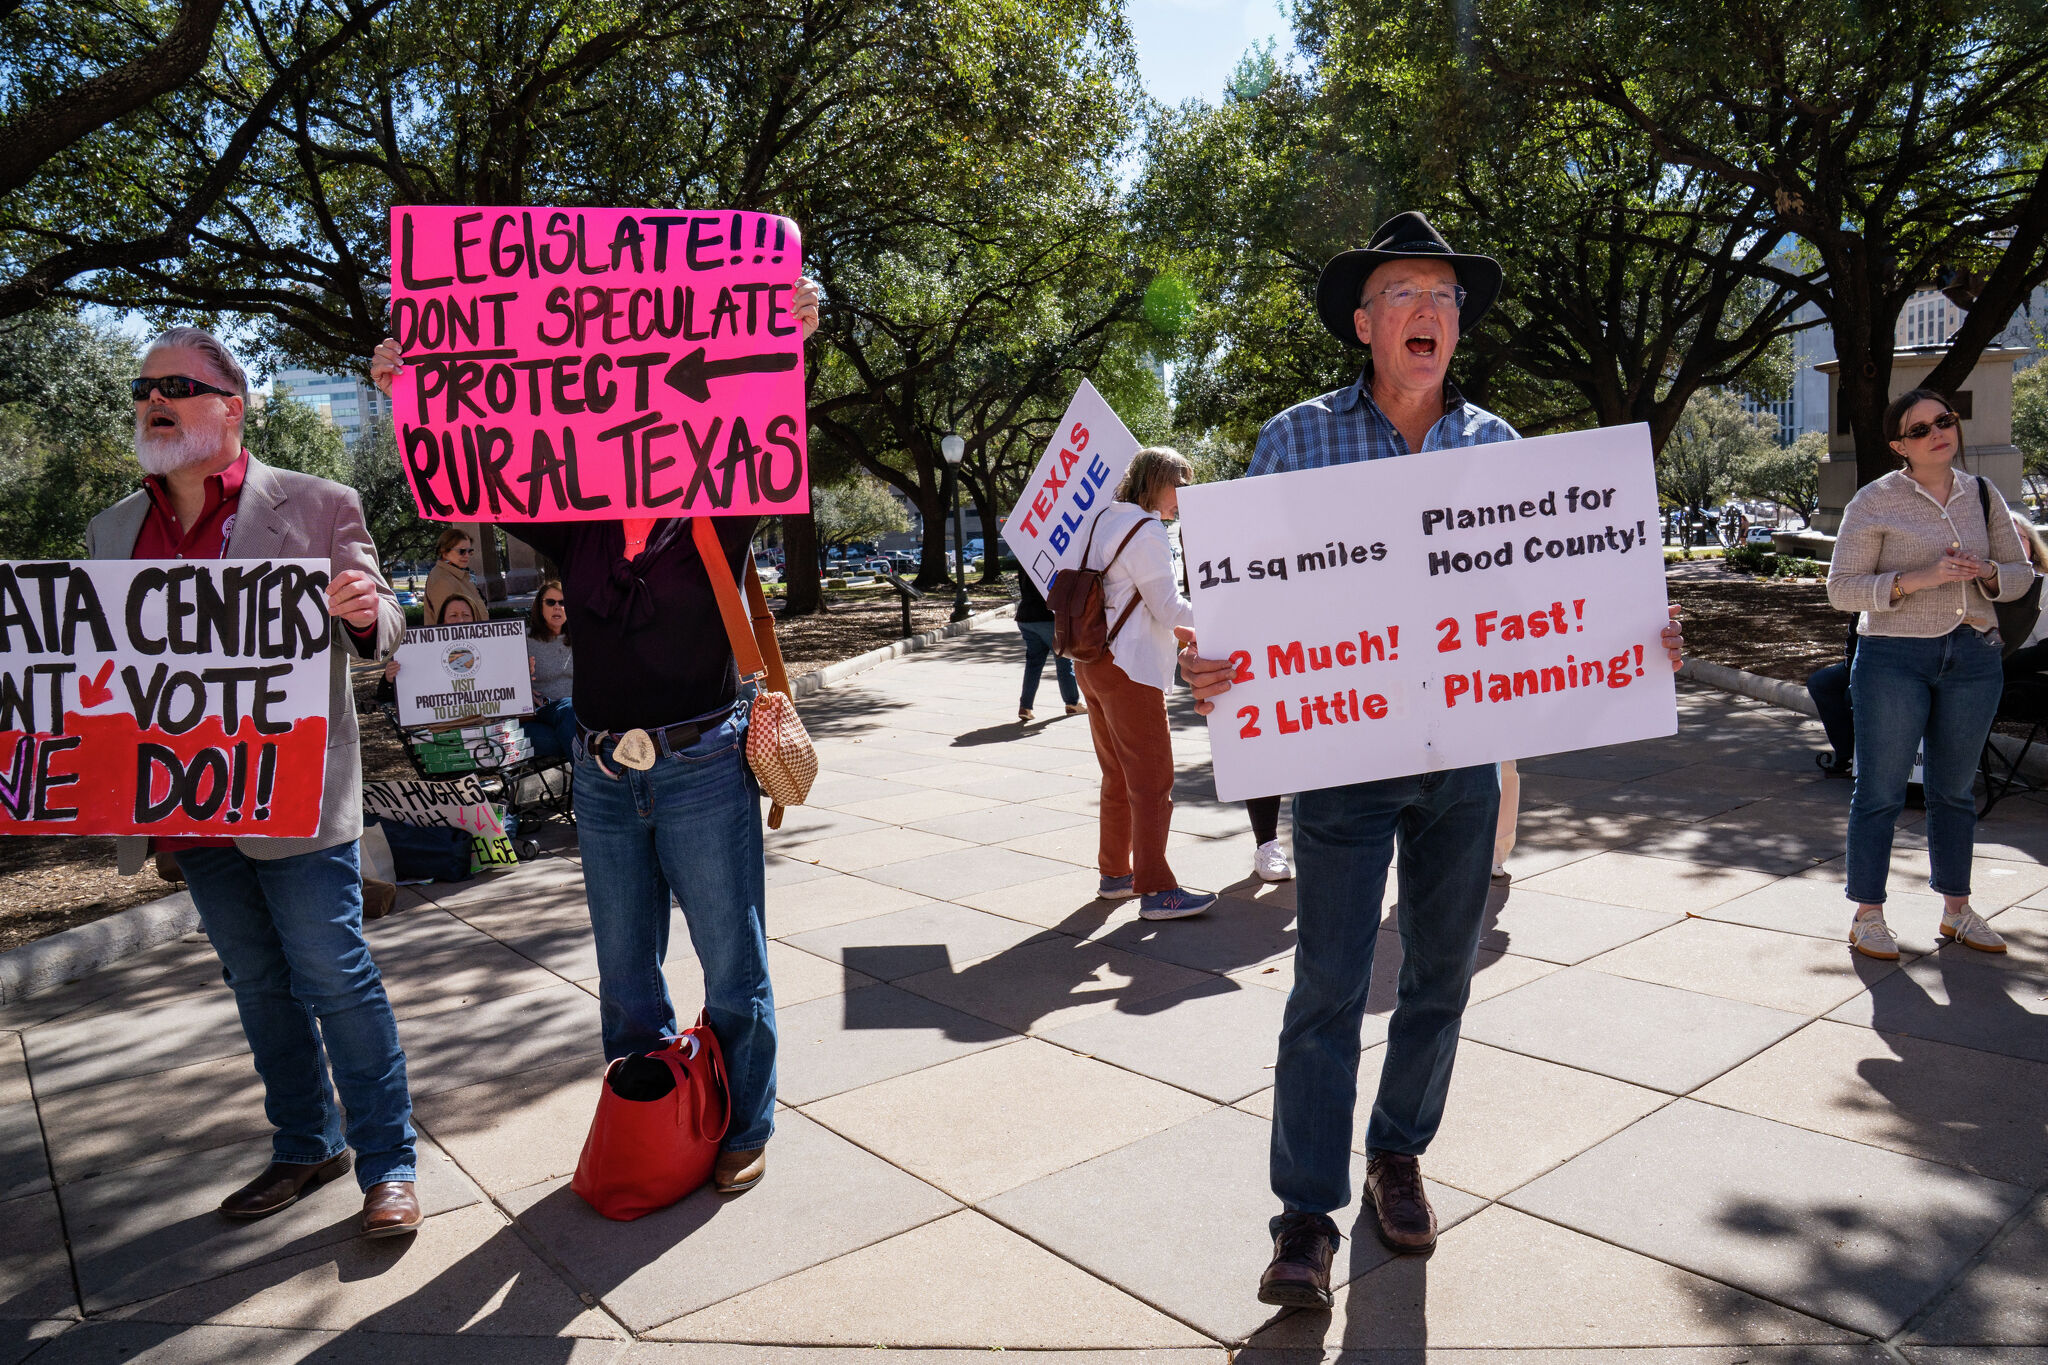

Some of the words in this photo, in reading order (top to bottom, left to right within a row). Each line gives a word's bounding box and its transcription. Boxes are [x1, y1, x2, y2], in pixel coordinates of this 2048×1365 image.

[400, 211, 787, 290] LEGISLATE!!!
[391, 291, 519, 352] DONT
[537, 283, 797, 348] SPECULATE
[415, 352, 671, 425] PROTECT
[403, 423, 611, 518] RURAL
[597, 411, 803, 510] TEXAS
[1019, 421, 1090, 539] TEXAS
[1048, 452, 1111, 557] BLUE
[1421, 490, 1557, 536] Planned
[1566, 486, 1617, 513] for
[1198, 556, 1240, 590] 11
[1247, 556, 1288, 581] sq
[1297, 538, 1389, 574] miles
[1428, 541, 1514, 577] Hood
[1523, 520, 1647, 565] County!
[0, 561, 117, 656] ATA
[125, 561, 330, 659] CENTERS
[420, 628, 435, 644] NO
[435, 627, 450, 643] TO
[451, 621, 522, 641] DATACENTERS!
[1229, 649, 1255, 685] 2
[1266, 625, 1401, 680] Much!
[1434, 616, 1463, 654] 2
[1473, 598, 1586, 649] Fast!
[121, 662, 294, 736] VOTE
[416, 687, 515, 709] PROTECTPALUXY.COM
[433, 706, 446, 720] TO
[447, 704, 478, 719] LEARN
[479, 701, 501, 716] HOW
[451, 678, 475, 692] VISIT
[1235, 705, 1262, 740] 2
[1275, 688, 1390, 736] Little
[1443, 644, 1645, 709] Planning!
[135, 741, 277, 824] DO!!
[397, 777, 485, 810] HUGHES
[472, 836, 518, 865] ELSE
